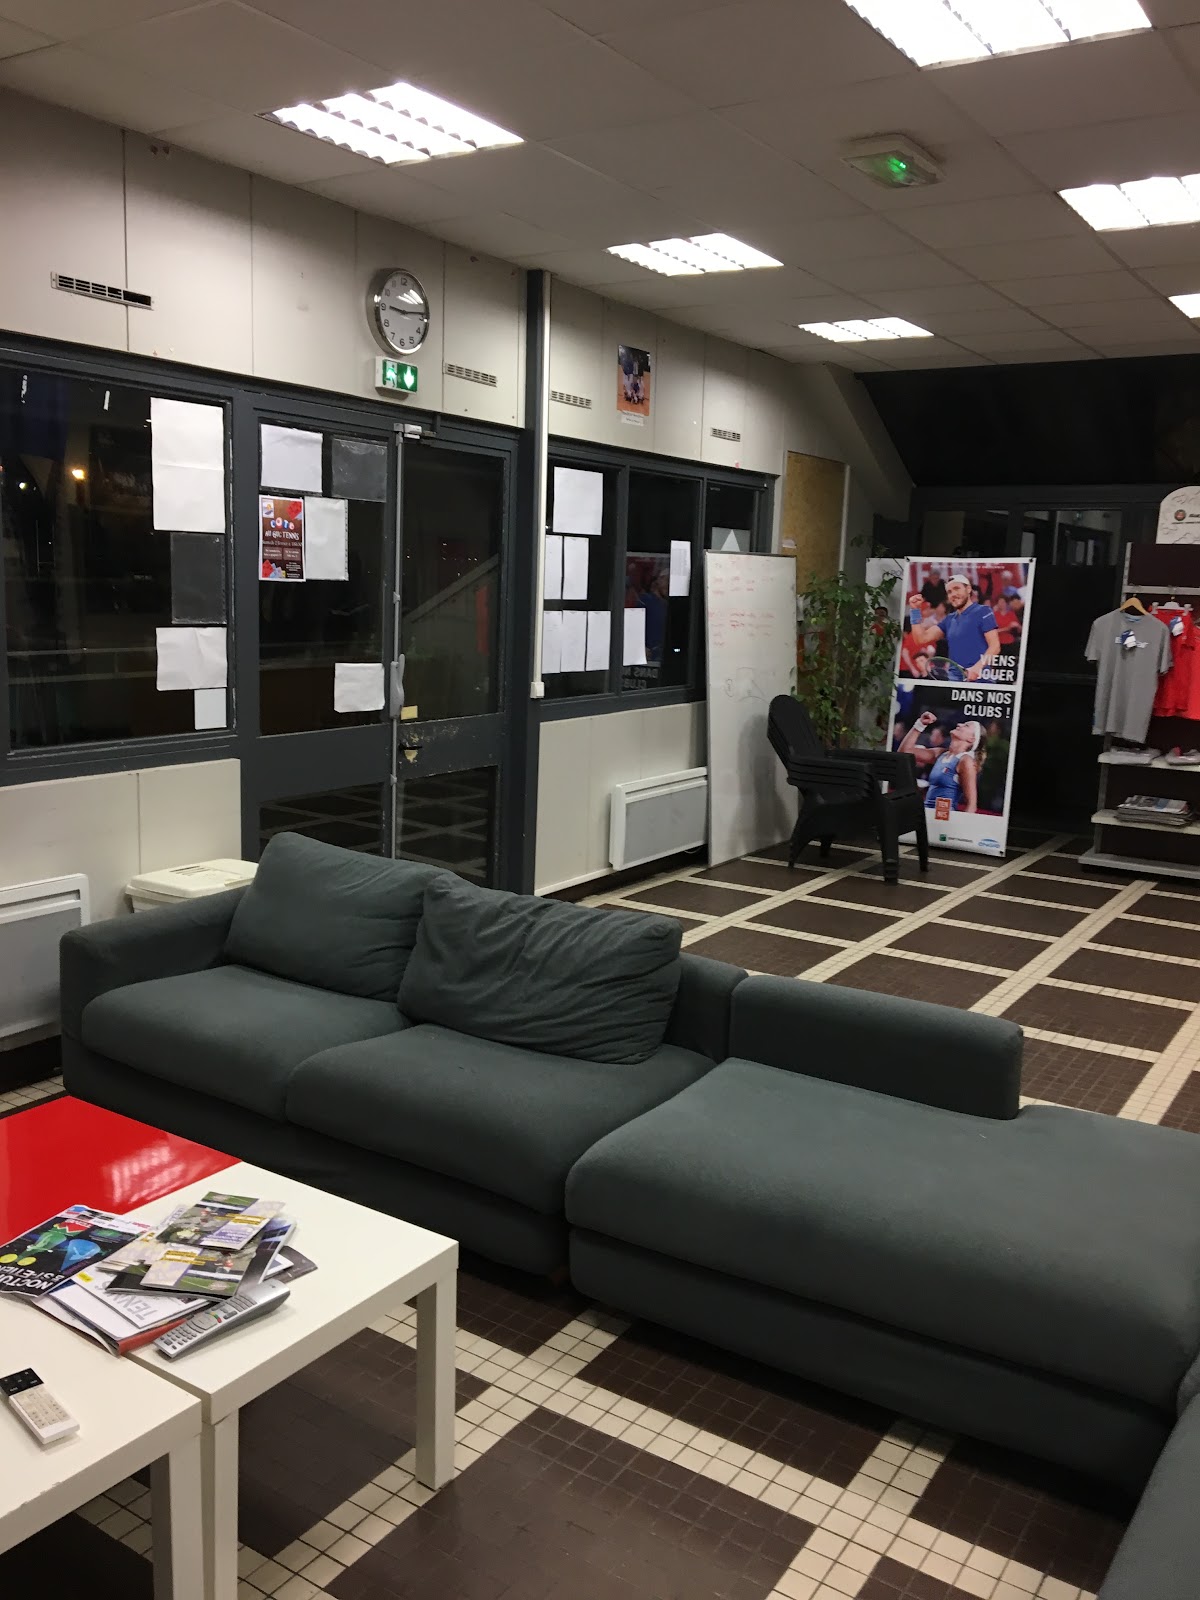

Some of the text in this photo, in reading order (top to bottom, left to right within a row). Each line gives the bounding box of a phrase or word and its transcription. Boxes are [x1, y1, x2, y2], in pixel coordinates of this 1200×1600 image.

[380, 303, 387, 311] 9
[384, 319, 390, 327] 8
[416, 327, 421, 335] 4
[390, 332, 396, 340] 7
[409, 336, 415, 344] 5
[399, 338, 405, 347] 6
[980, 654, 1016, 668] VIENS
[977, 668, 1014, 682] JOUER
[951, 689, 1012, 705] DANS NOS
[963, 704, 1011, 719] CLUBS !
